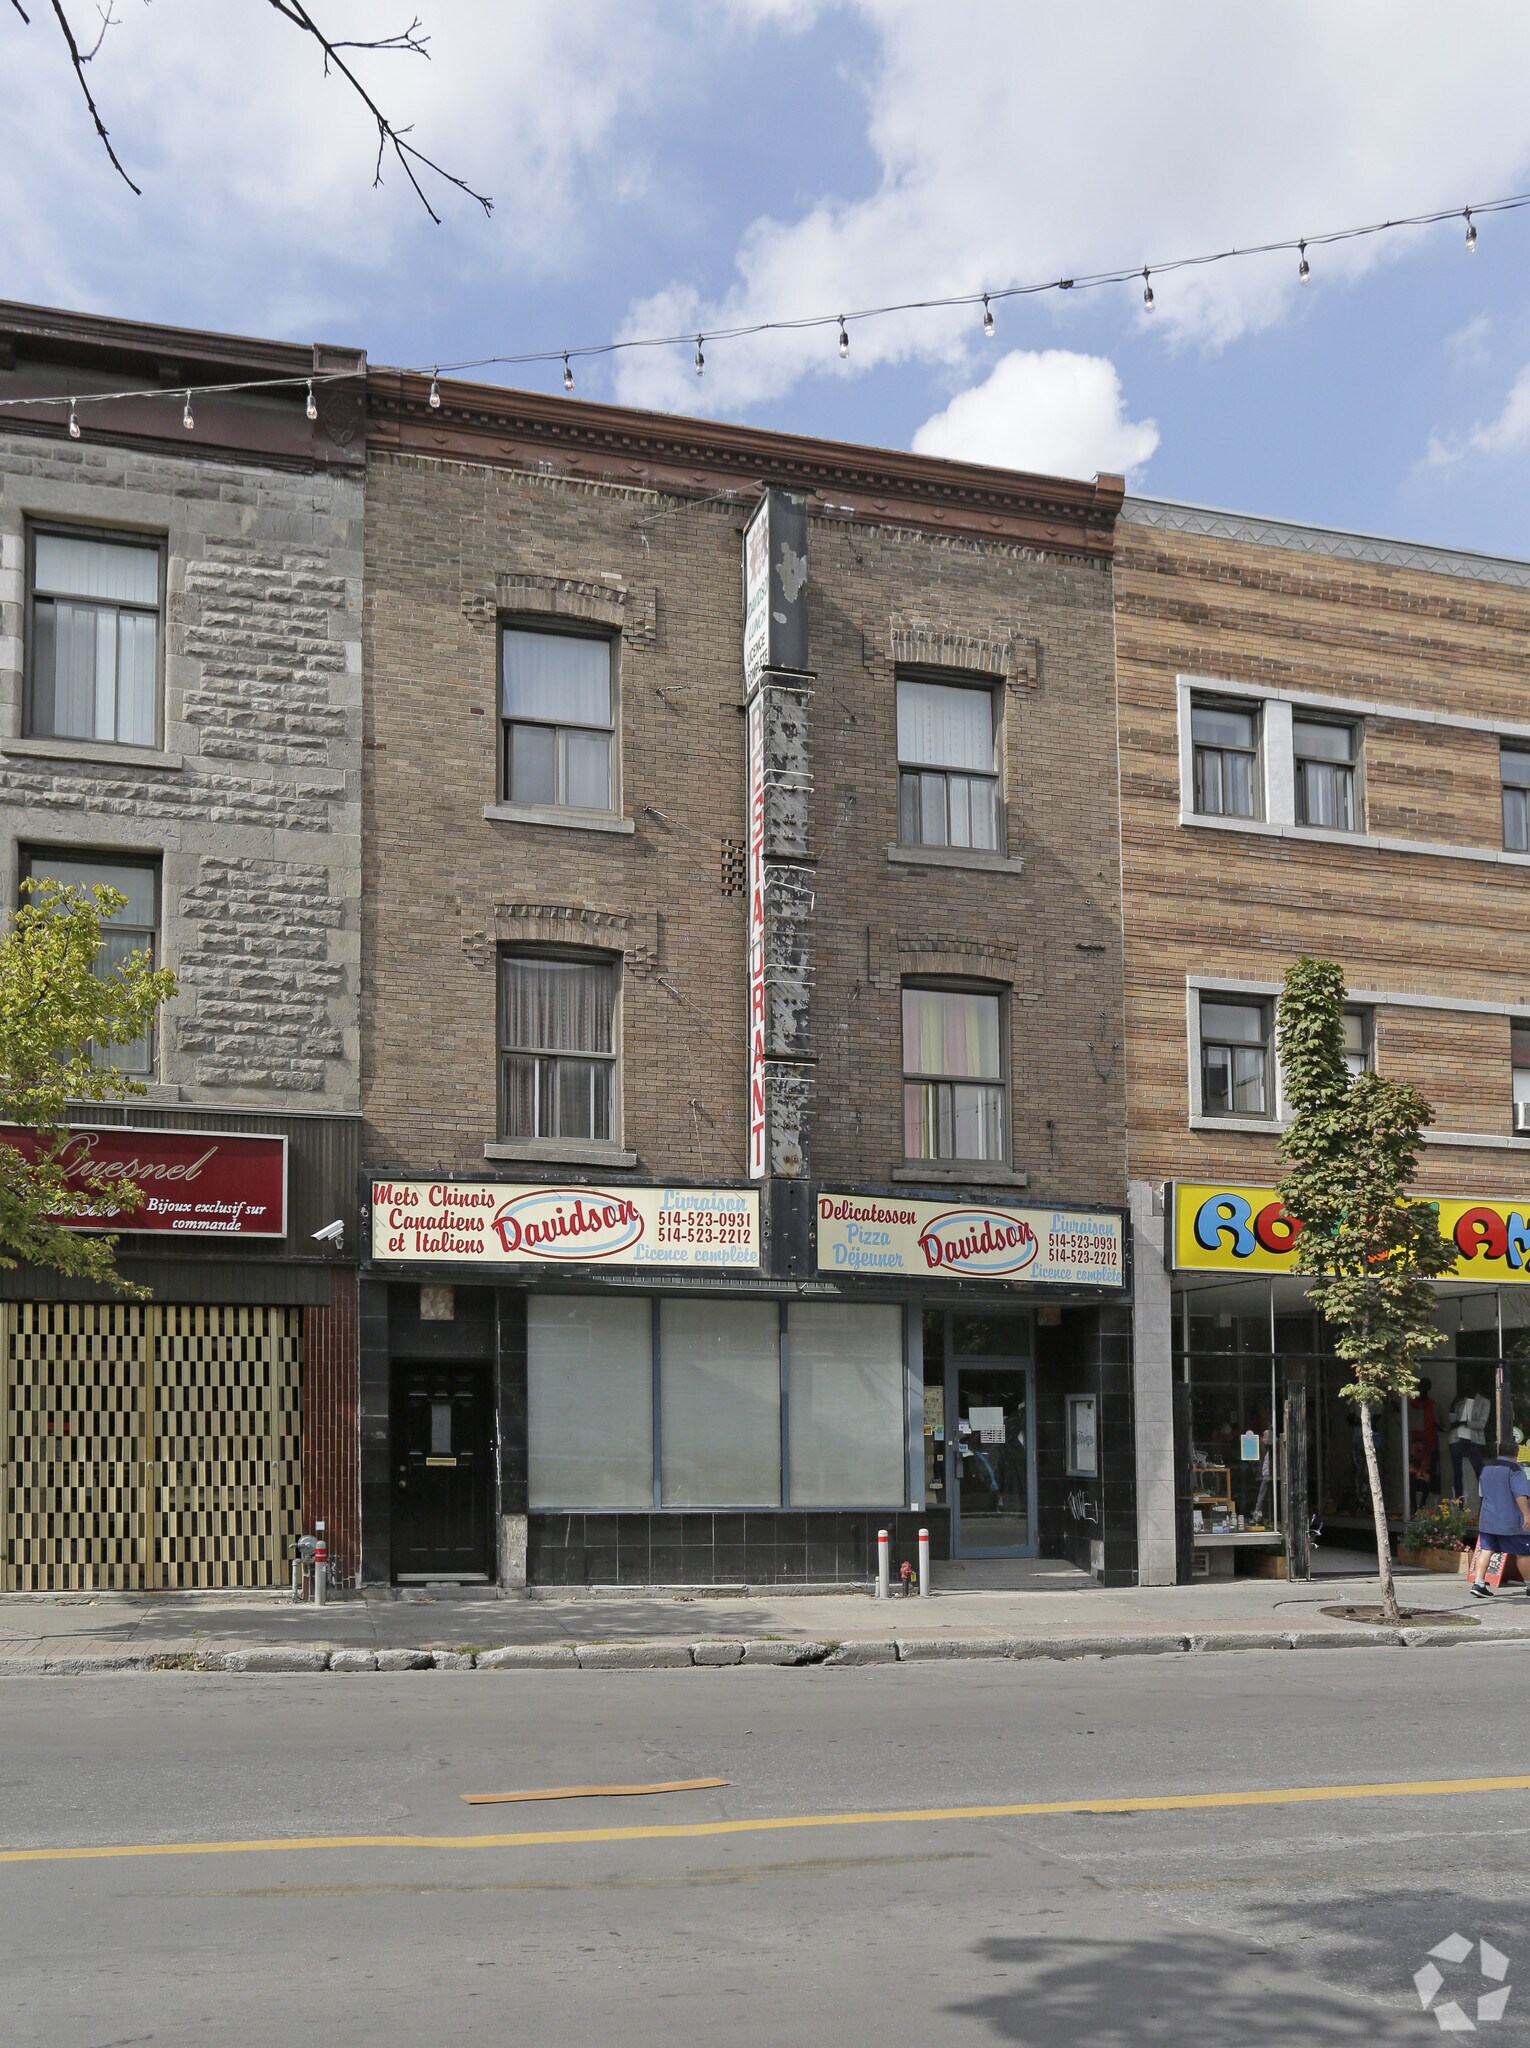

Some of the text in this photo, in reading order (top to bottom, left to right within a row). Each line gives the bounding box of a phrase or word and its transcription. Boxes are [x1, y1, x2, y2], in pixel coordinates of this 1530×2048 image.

[747, 632, 766, 666] LICENCE
[751, 700, 765, 1168] RESTAURANT
[147, 1198, 266, 1217] Bijoux exclusif sur
[373, 1184, 496, 1208] Mets Chinois
[660, 1189, 748, 1212] Livraison
[389, 1208, 485, 1232] Canadiens
[658, 1211, 751, 1228] 514-523-0931
[818, 1198, 917, 1225] Delicatessen
[172, 1217, 242, 1231] commande
[491, 1200, 640, 1253] Davidson
[658, 1227, 751, 1244] 514-523-2212
[846, 1222, 891, 1245] Pizza
[1050, 1213, 1115, 1237] Livraison
[388, 1231, 485, 1254] et Italiens
[917, 1220, 1035, 1269] Davidson
[1048, 1233, 1118, 1251] 514-523-0931
[633, 1243, 759, 1266] Licence complète
[832, 1243, 904, 1270] Déjeuner
[1048, 1249, 1118, 1266] 514-523-2212
[1030, 1261, 1123, 1284] Licence complète
